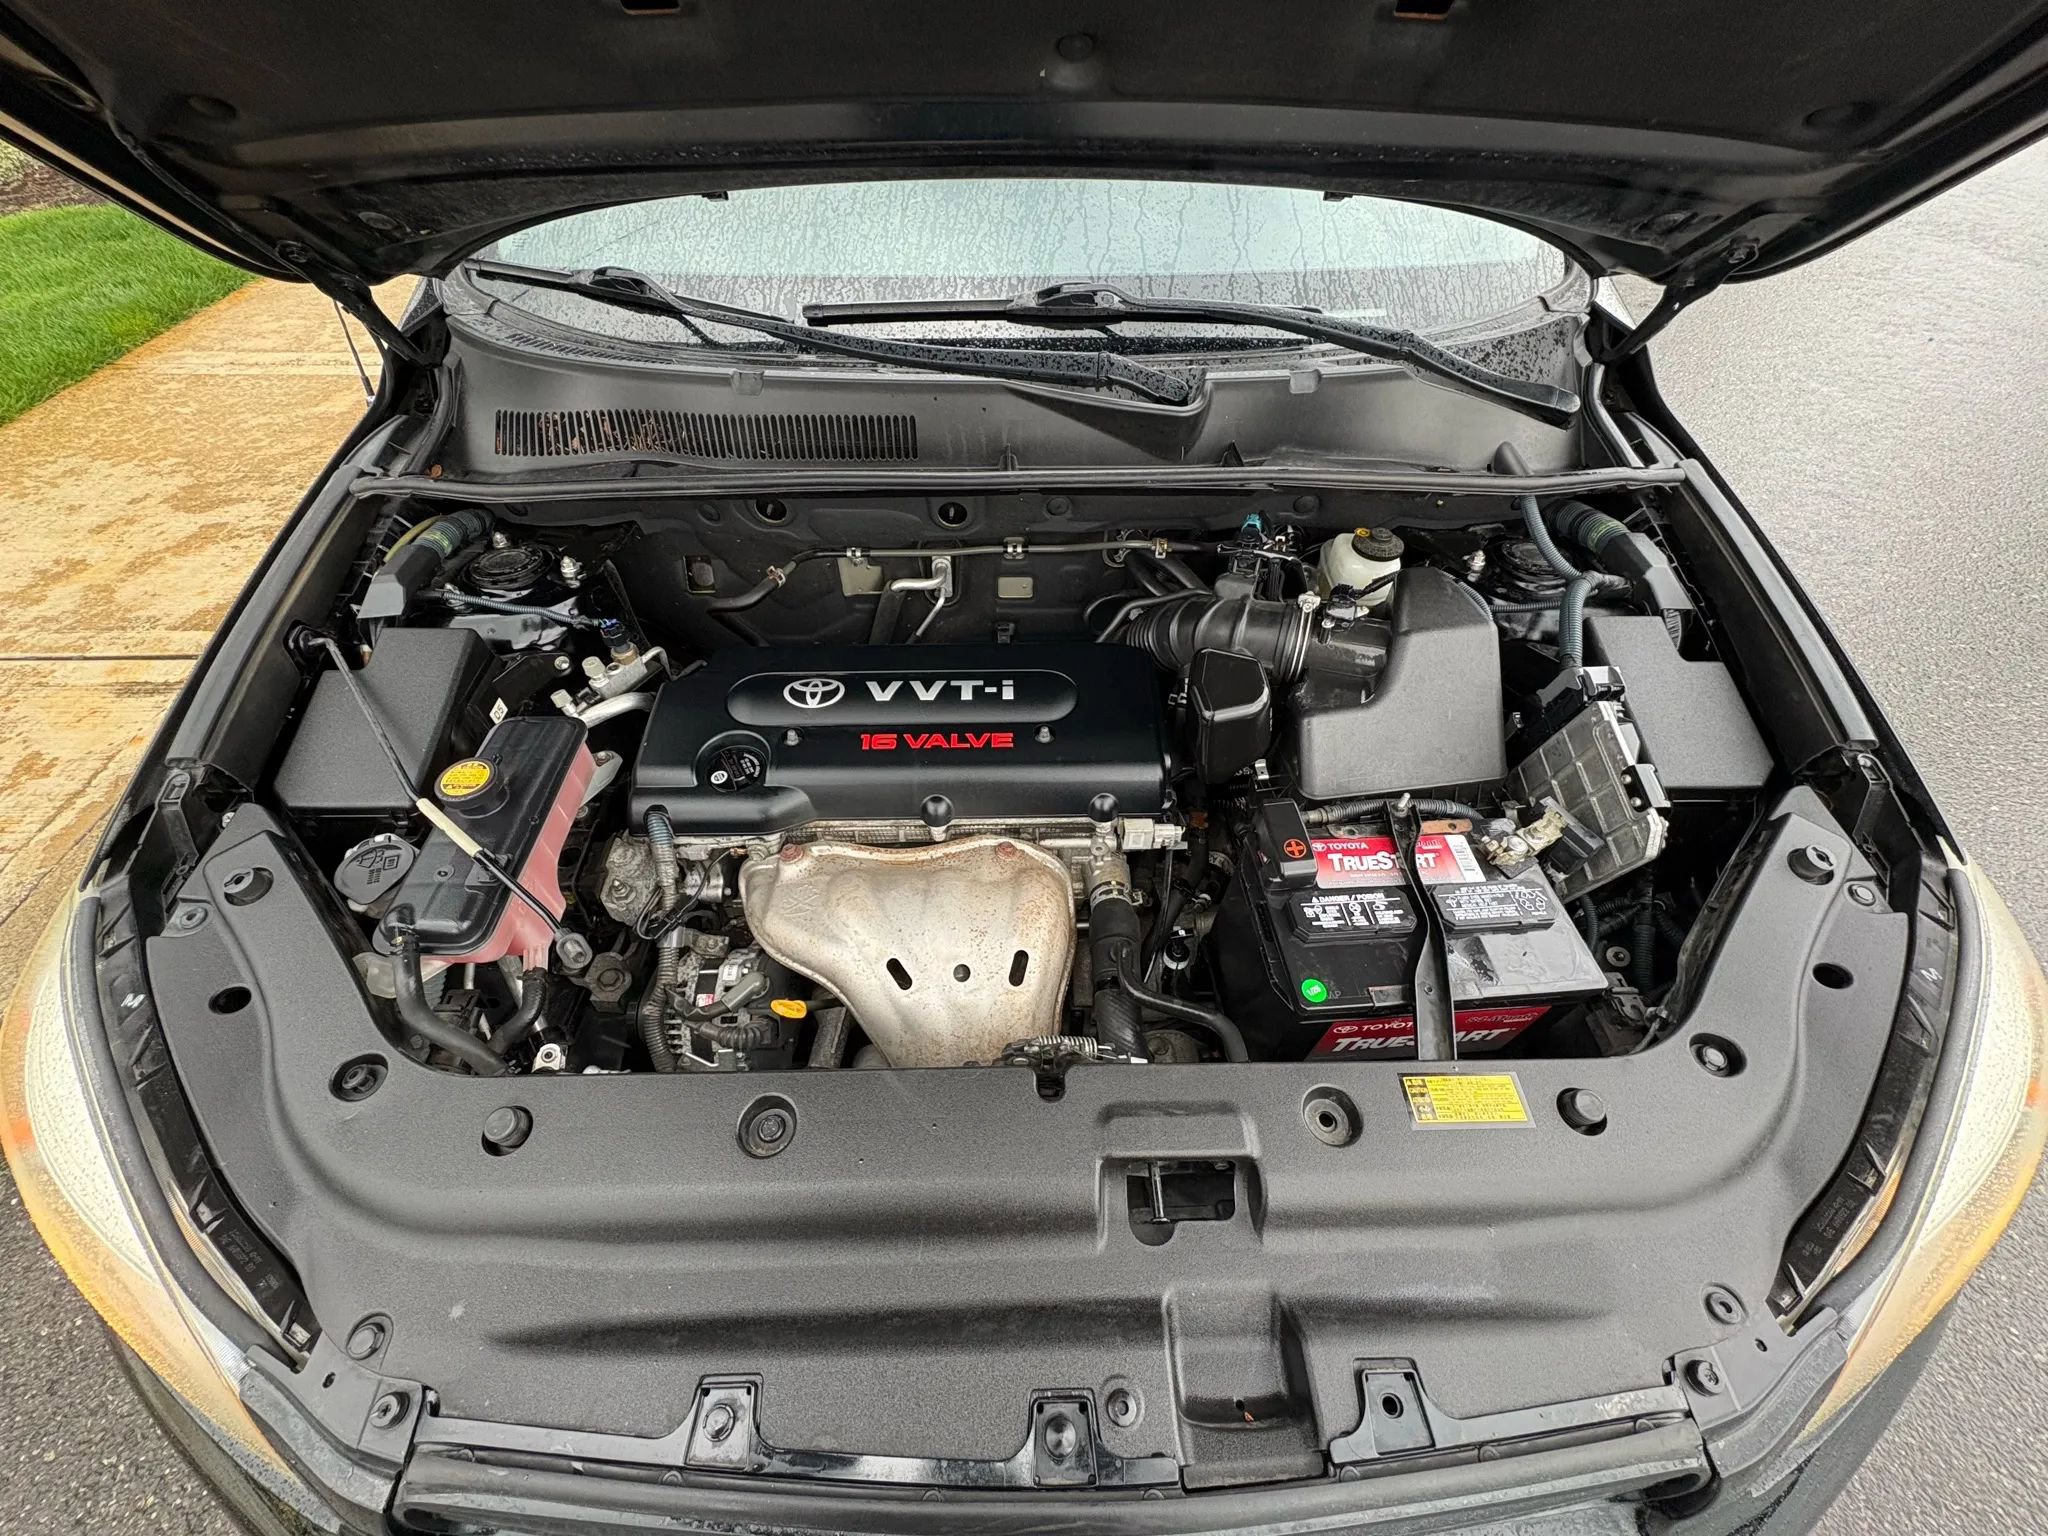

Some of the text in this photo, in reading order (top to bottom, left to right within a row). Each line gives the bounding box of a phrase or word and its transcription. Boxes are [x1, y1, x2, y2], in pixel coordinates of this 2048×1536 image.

[865, 680, 1014, 701] VVT-i
[860, 733, 1014, 750] 16 VALVE
[1327, 842, 1369, 850] TOYOTA
